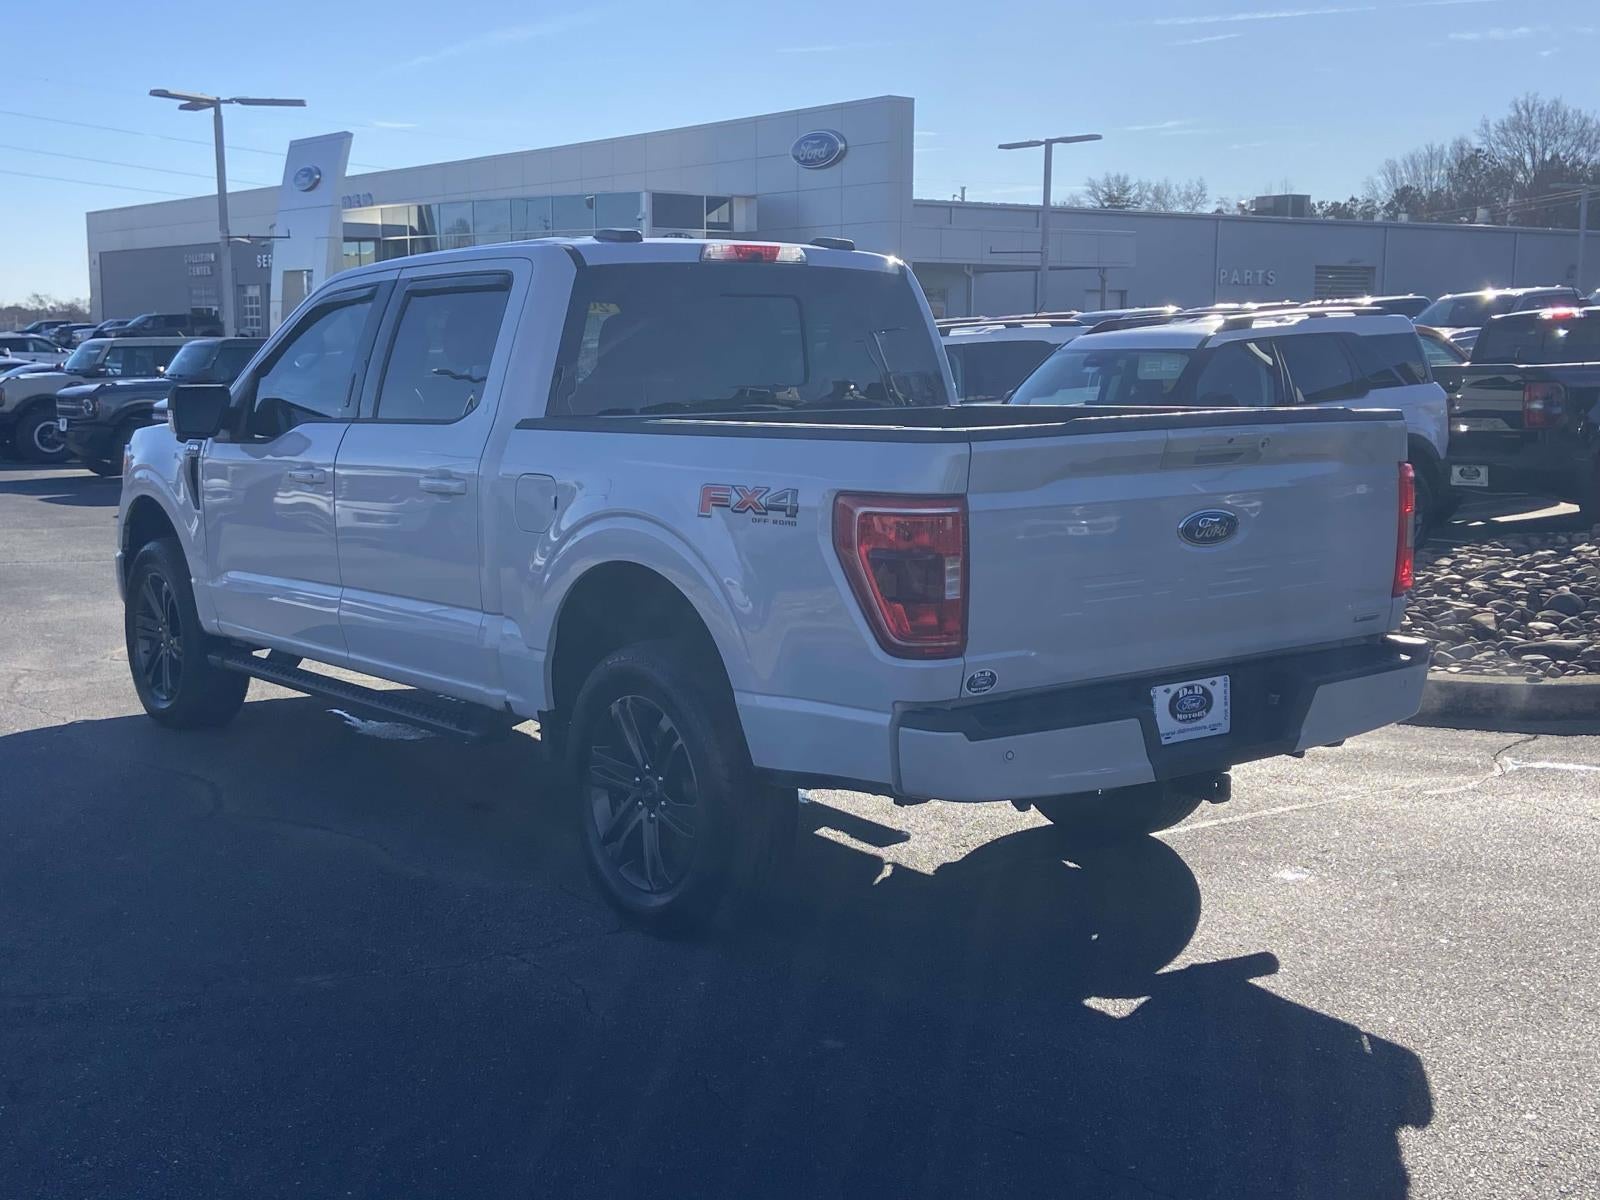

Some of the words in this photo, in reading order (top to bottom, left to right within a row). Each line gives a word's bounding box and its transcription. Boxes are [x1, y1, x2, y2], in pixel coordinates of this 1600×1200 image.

[1220, 269, 1276, 285] PARTS
[698, 483, 799, 518] FX4
[772, 519, 797, 527] ROAD
[1195, 518, 1227, 538] Ford
[1178, 685, 1203, 698] D&D
